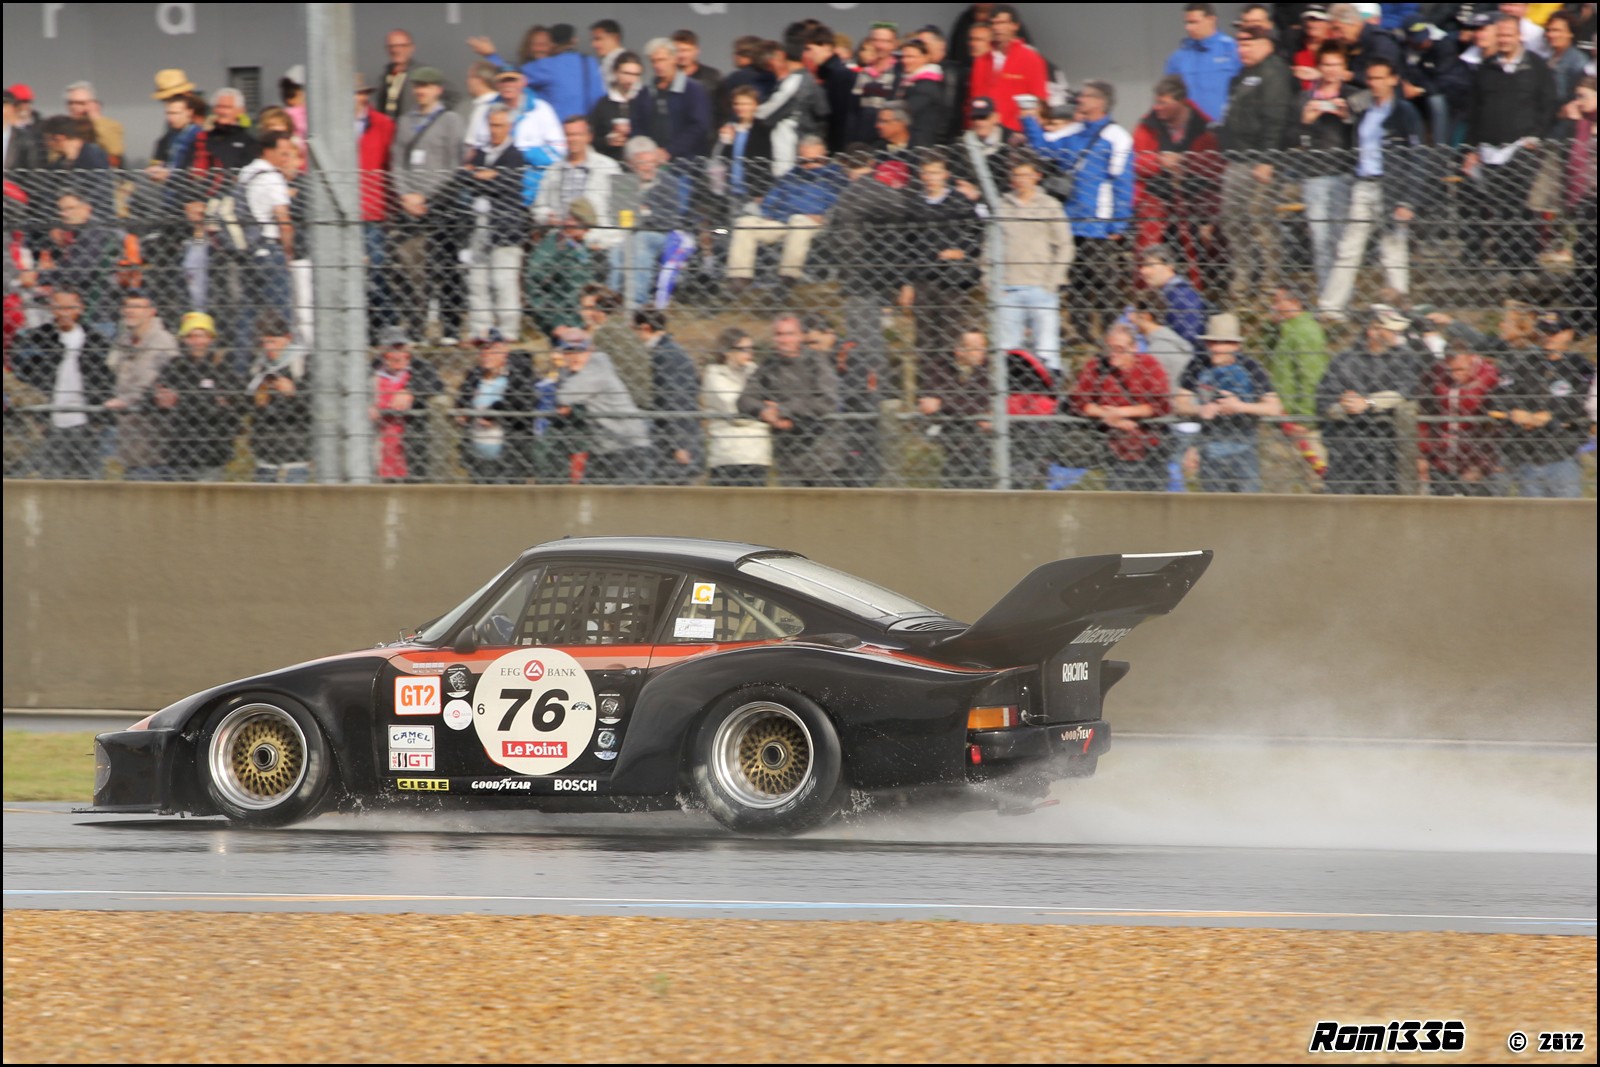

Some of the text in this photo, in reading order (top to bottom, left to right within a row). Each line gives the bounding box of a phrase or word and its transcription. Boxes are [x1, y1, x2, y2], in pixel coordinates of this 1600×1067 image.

[695, 585, 712, 602] C
[500, 667, 576, 677] EFG BANK
[1062, 662, 1089, 682] RACING
[400, 684, 436, 707] GT2
[477, 703, 486, 715] 6
[497, 688, 569, 732] 76
[392, 731, 431, 742] CAMEL
[506, 742, 563, 756] Le Point
[408, 754, 432, 767] GT
[399, 780, 448, 790] CIBIE
[471, 777, 532, 791] GOODYEAR
[554, 779, 597, 792] BOSCH
